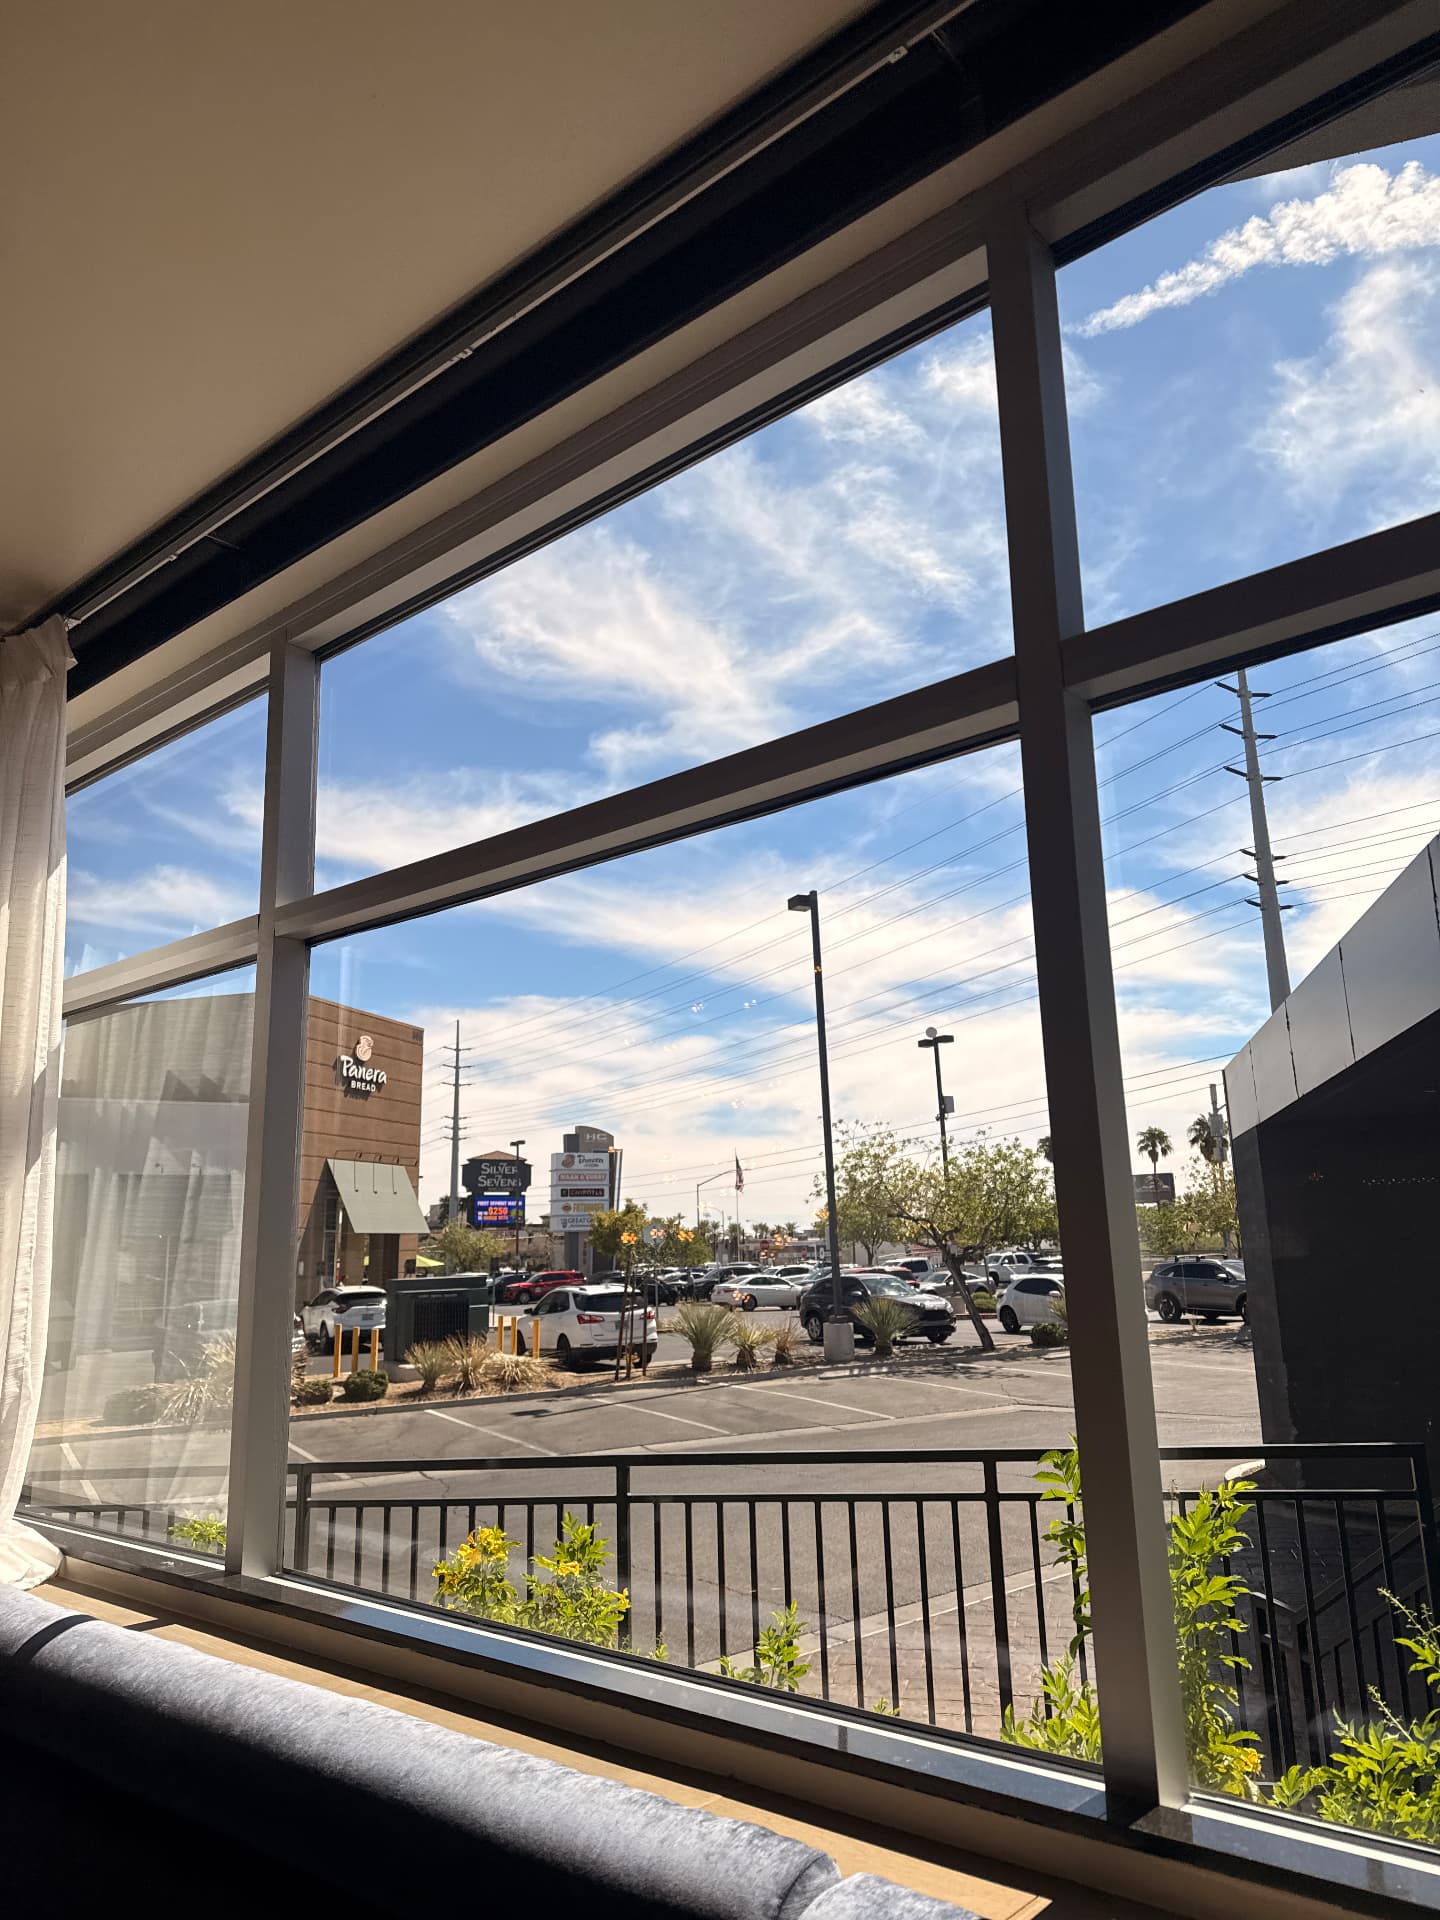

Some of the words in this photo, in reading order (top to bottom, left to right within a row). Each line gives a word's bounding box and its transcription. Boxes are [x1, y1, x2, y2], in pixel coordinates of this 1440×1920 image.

[340, 1055, 387, 1084] Panera
[350, 1080, 376, 1092] BREAD
[481, 1162, 518, 1175] SILVER
